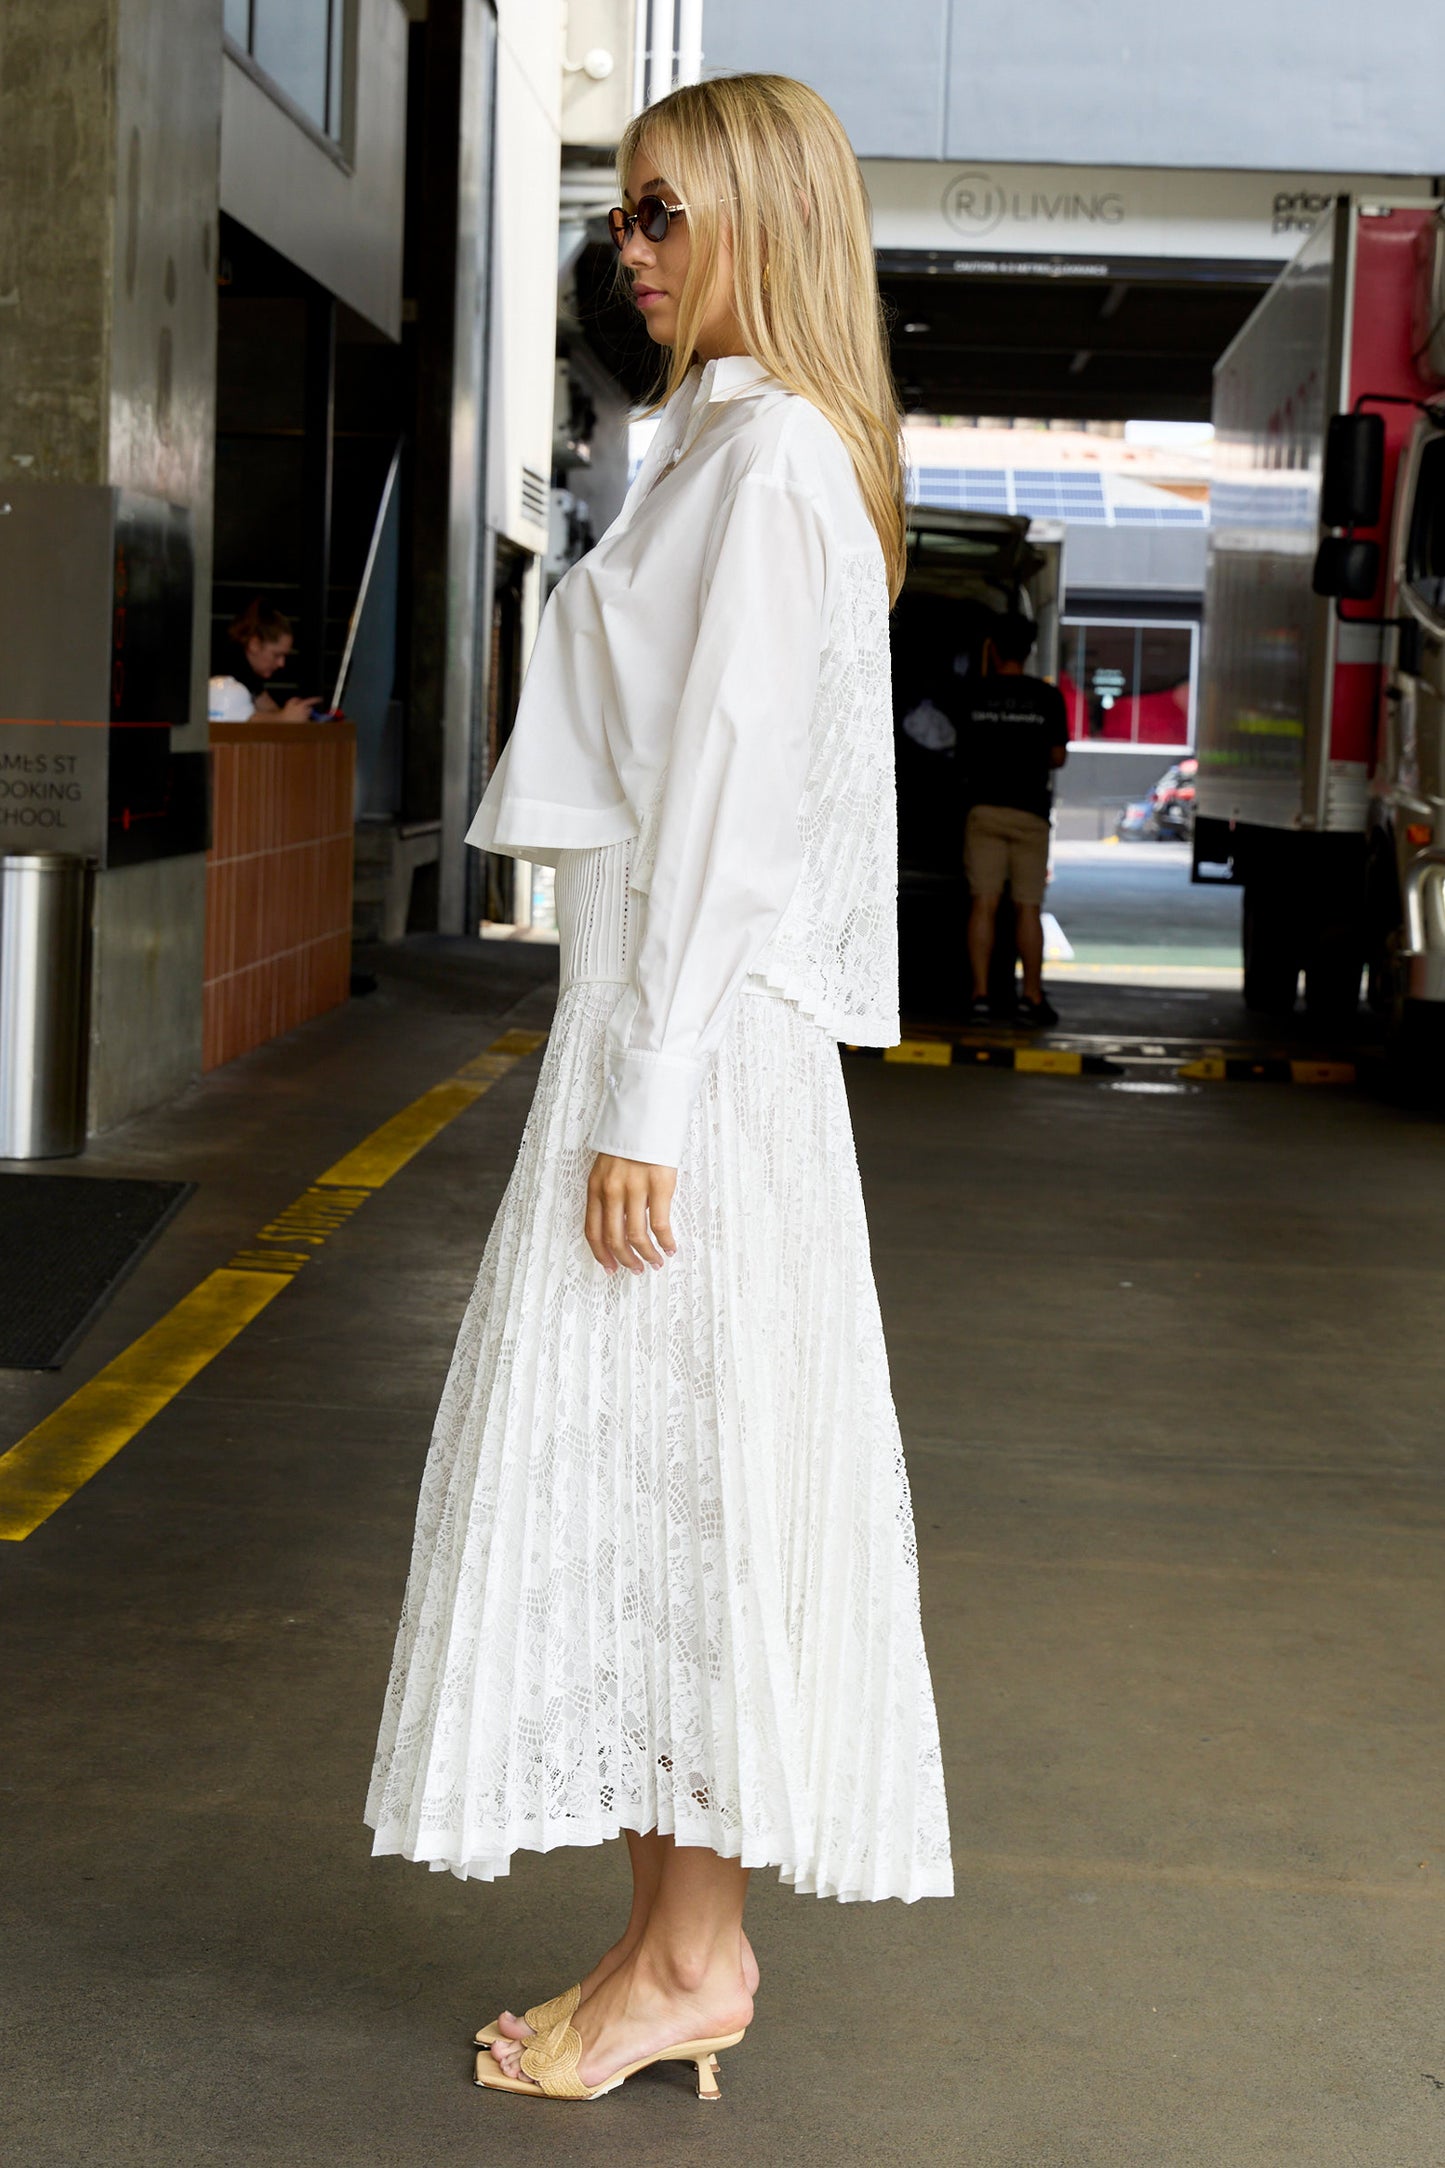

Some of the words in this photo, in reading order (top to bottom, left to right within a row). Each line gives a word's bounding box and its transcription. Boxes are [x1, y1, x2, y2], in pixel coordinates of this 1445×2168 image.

[954, 189, 993, 221] RJ
[1012, 191, 1125, 225] LIVING
[0, 753, 48, 774] MES
[54, 754, 78, 774] ST
[0, 806, 67, 829] HOOL
